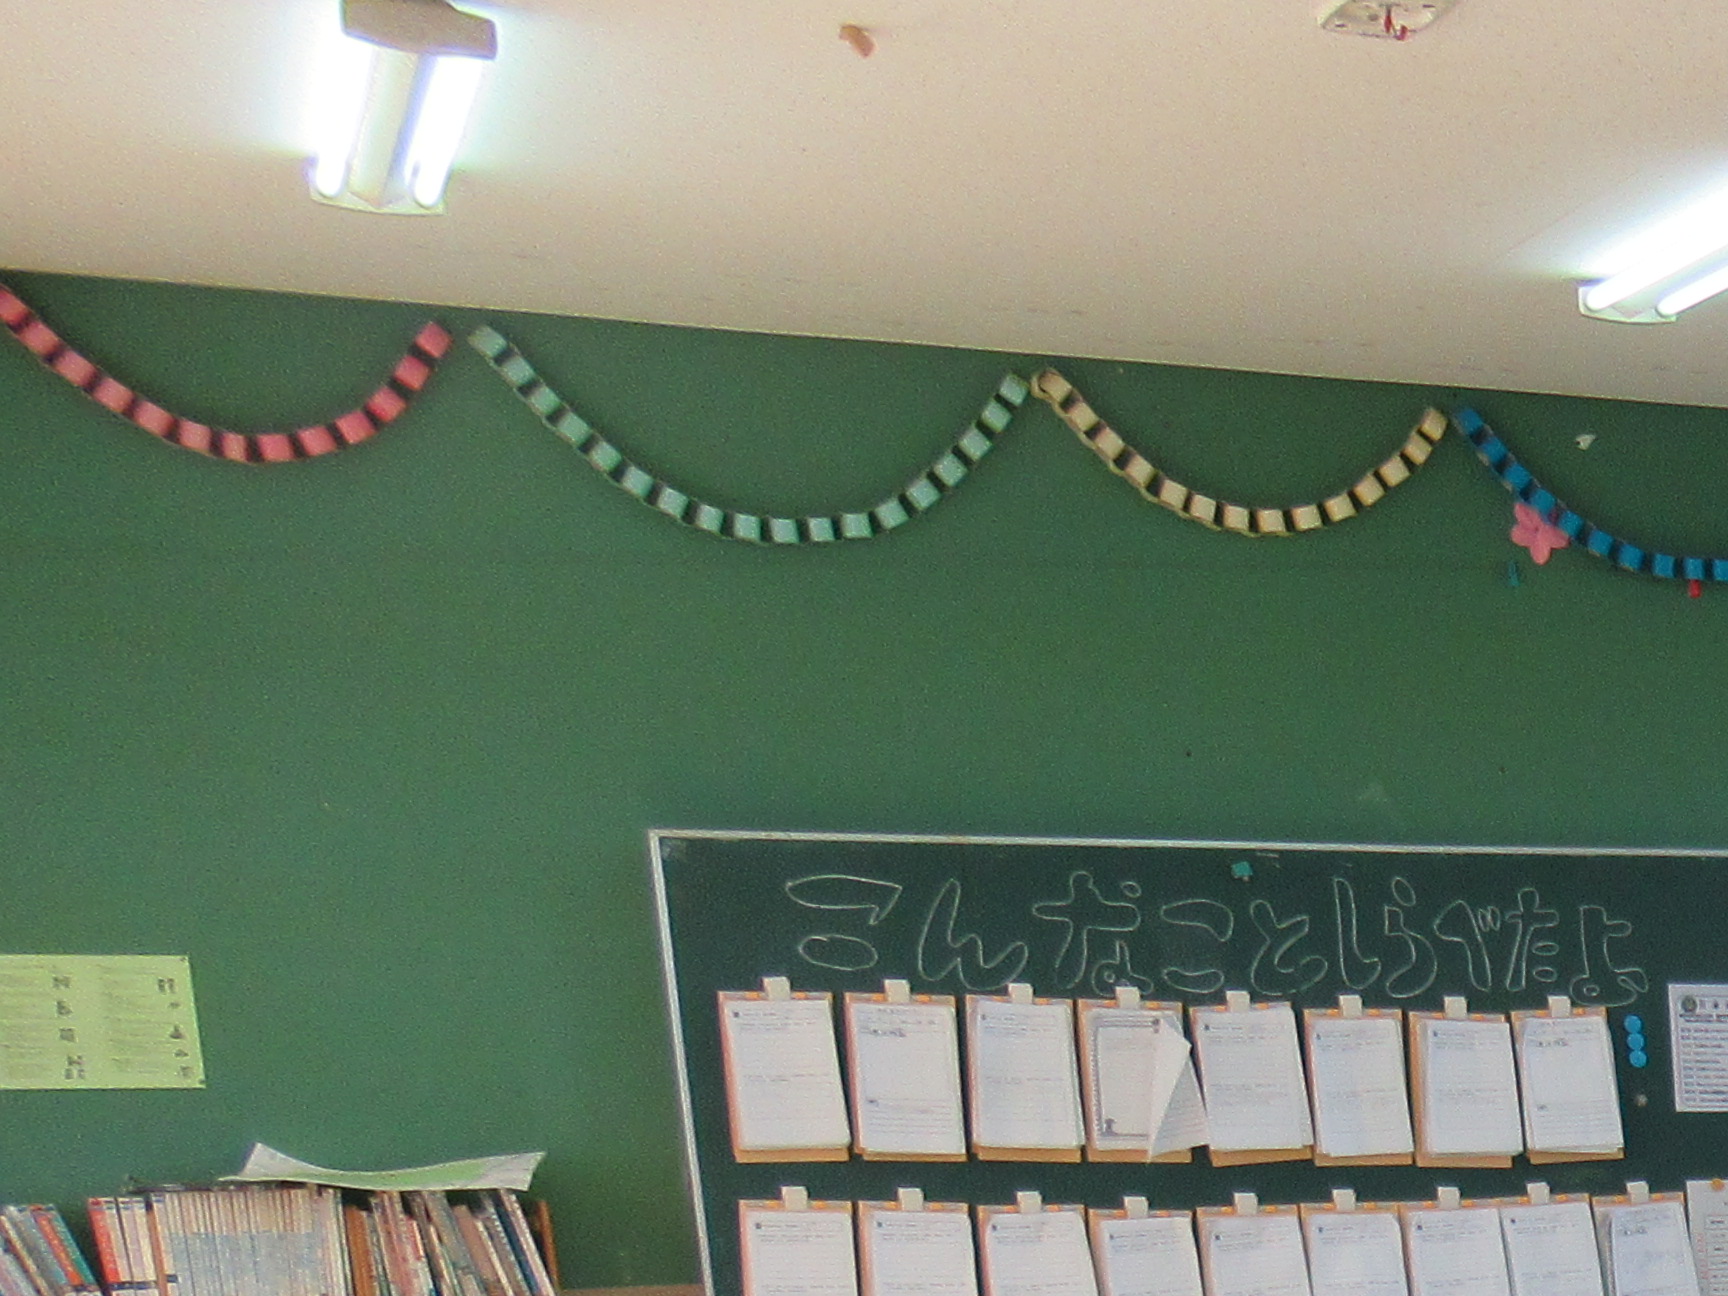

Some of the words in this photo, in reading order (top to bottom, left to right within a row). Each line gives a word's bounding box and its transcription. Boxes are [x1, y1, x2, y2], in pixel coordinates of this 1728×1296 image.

[785, 869, 1648, 1006] こんなことしらべたよ
